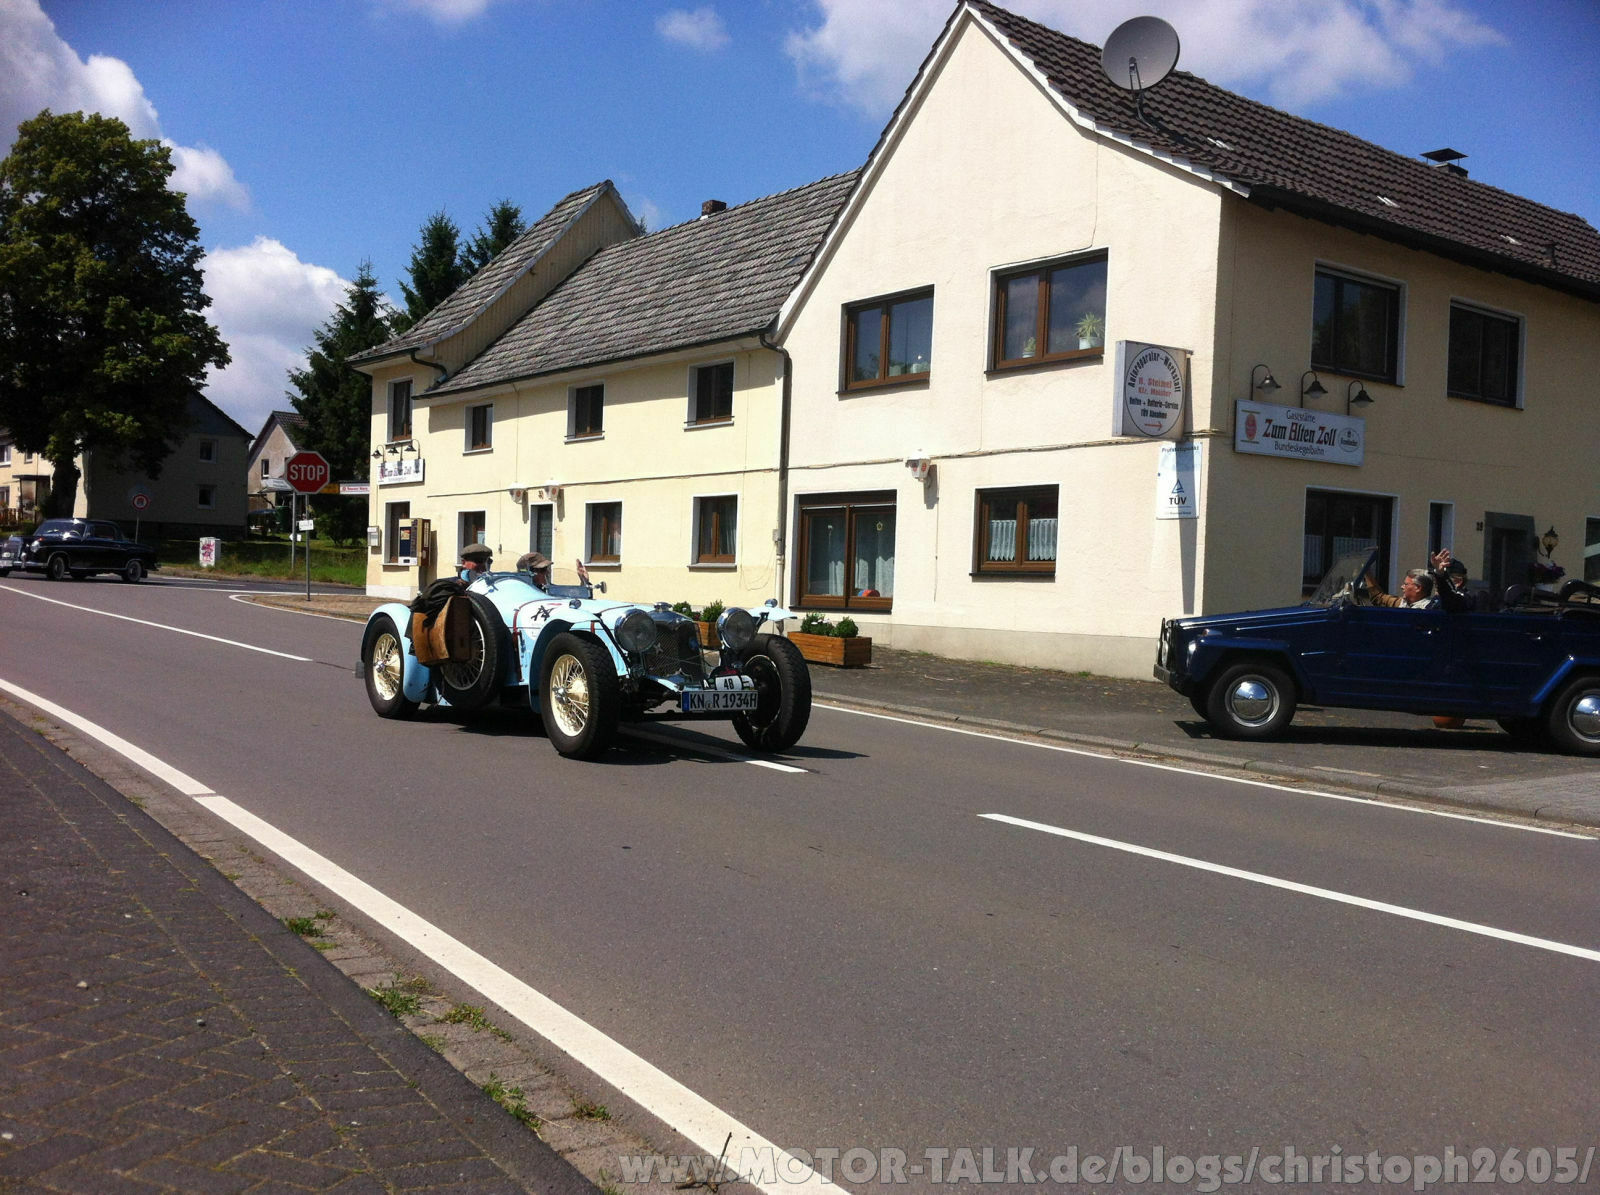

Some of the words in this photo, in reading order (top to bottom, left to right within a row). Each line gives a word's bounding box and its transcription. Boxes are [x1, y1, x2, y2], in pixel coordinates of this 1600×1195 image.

[1286, 410, 1316, 423] Gaststätte
[1262, 419, 1286, 440] Zum
[1288, 422, 1316, 444] Alten
[1316, 426, 1338, 447] Zoll
[1274, 441, 1325, 457] Bundeskegelbahn
[290, 464, 325, 481] STOP
[1168, 495, 1187, 505] TÜV
[690, 694, 705, 709] KN
[712, 694, 720, 709] R
[723, 693, 757, 708] 1934H
